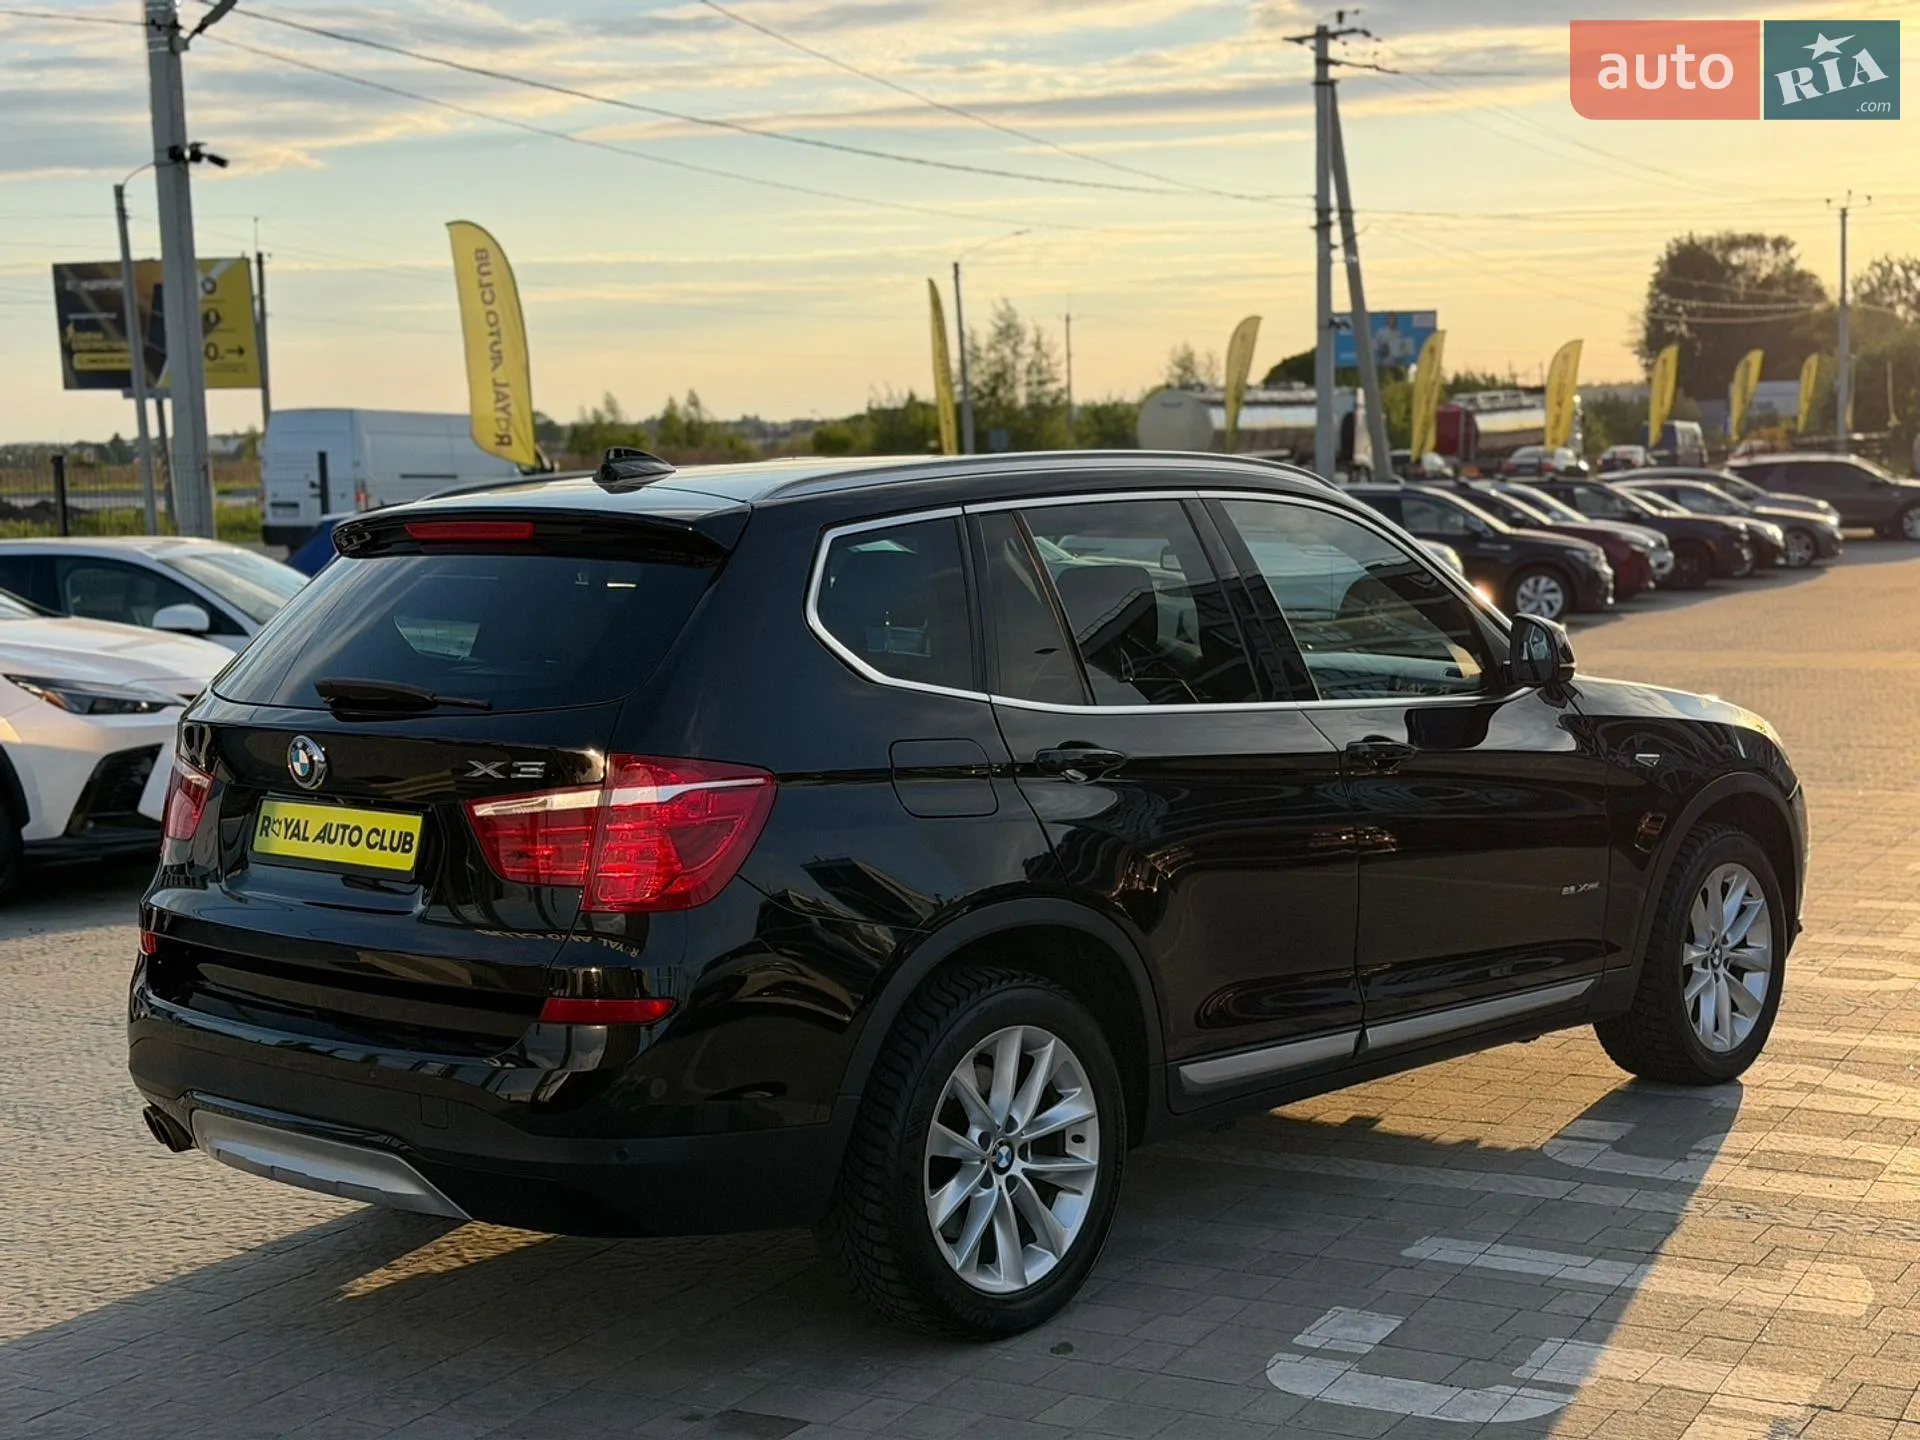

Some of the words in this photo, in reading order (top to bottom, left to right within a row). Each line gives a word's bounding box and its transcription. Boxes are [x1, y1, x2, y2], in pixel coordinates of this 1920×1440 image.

[463, 760, 546, 779] X3
[312, 822, 363, 848] AUTO
[365, 827, 415, 854] CLUB
